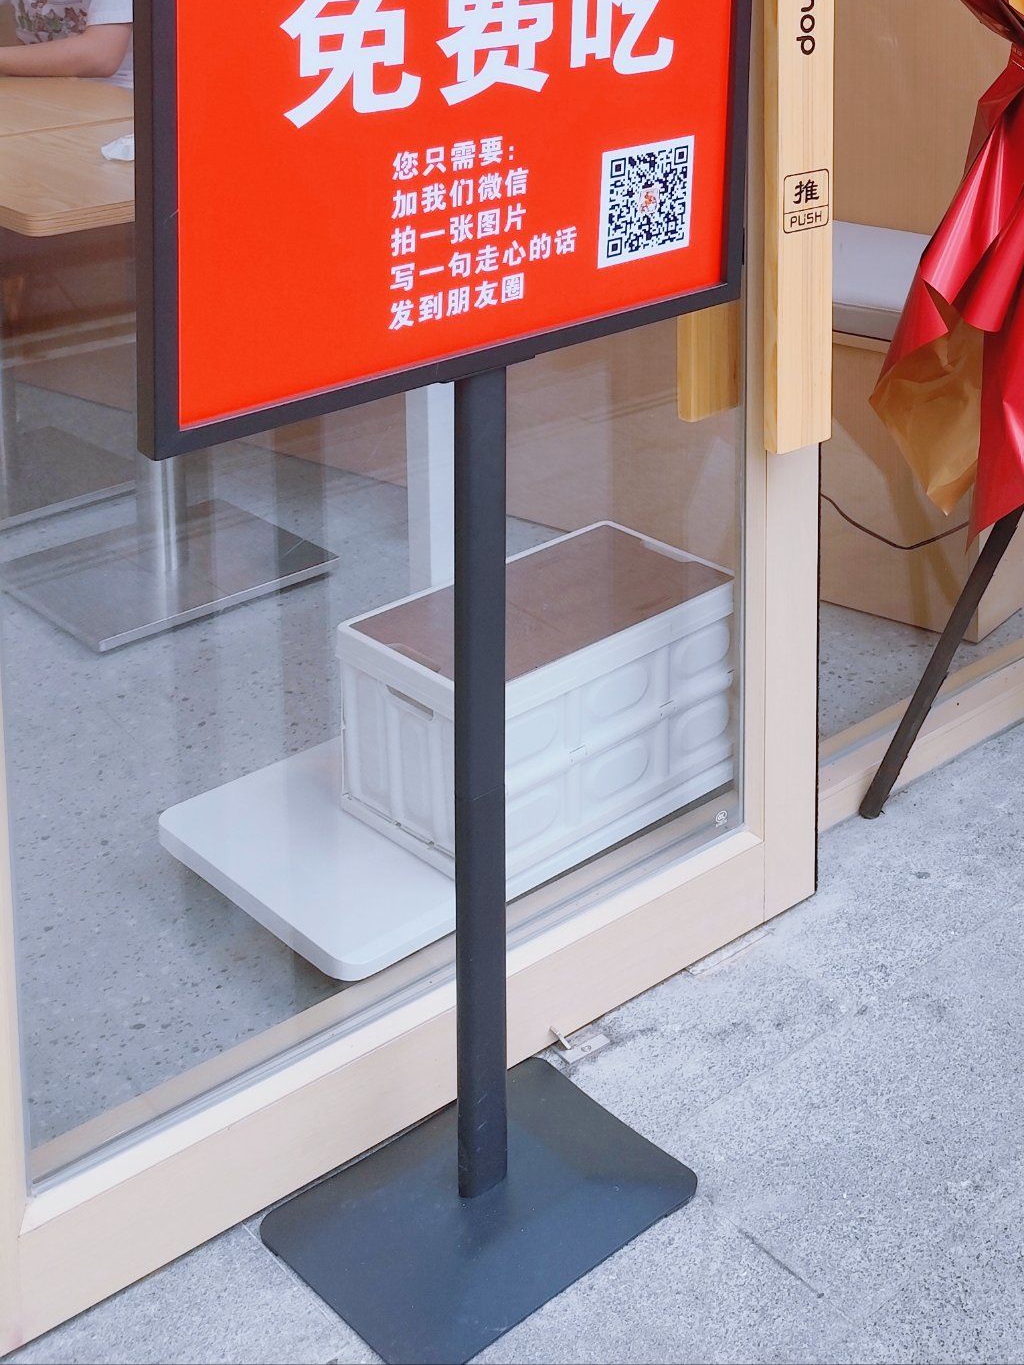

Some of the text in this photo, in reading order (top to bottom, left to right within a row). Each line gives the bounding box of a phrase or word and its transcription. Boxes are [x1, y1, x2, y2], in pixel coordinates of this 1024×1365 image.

[392, 136, 515, 181] 您只需要：
[391, 167, 529, 219] 加我们微信
[793, 179, 819, 204] 推
[391, 203, 527, 257] 拍一张图片
[790, 211, 822, 227] PUSH
[389, 226, 577, 291] 写一句走心的话
[388, 272, 525, 330] 发到朋友圈
